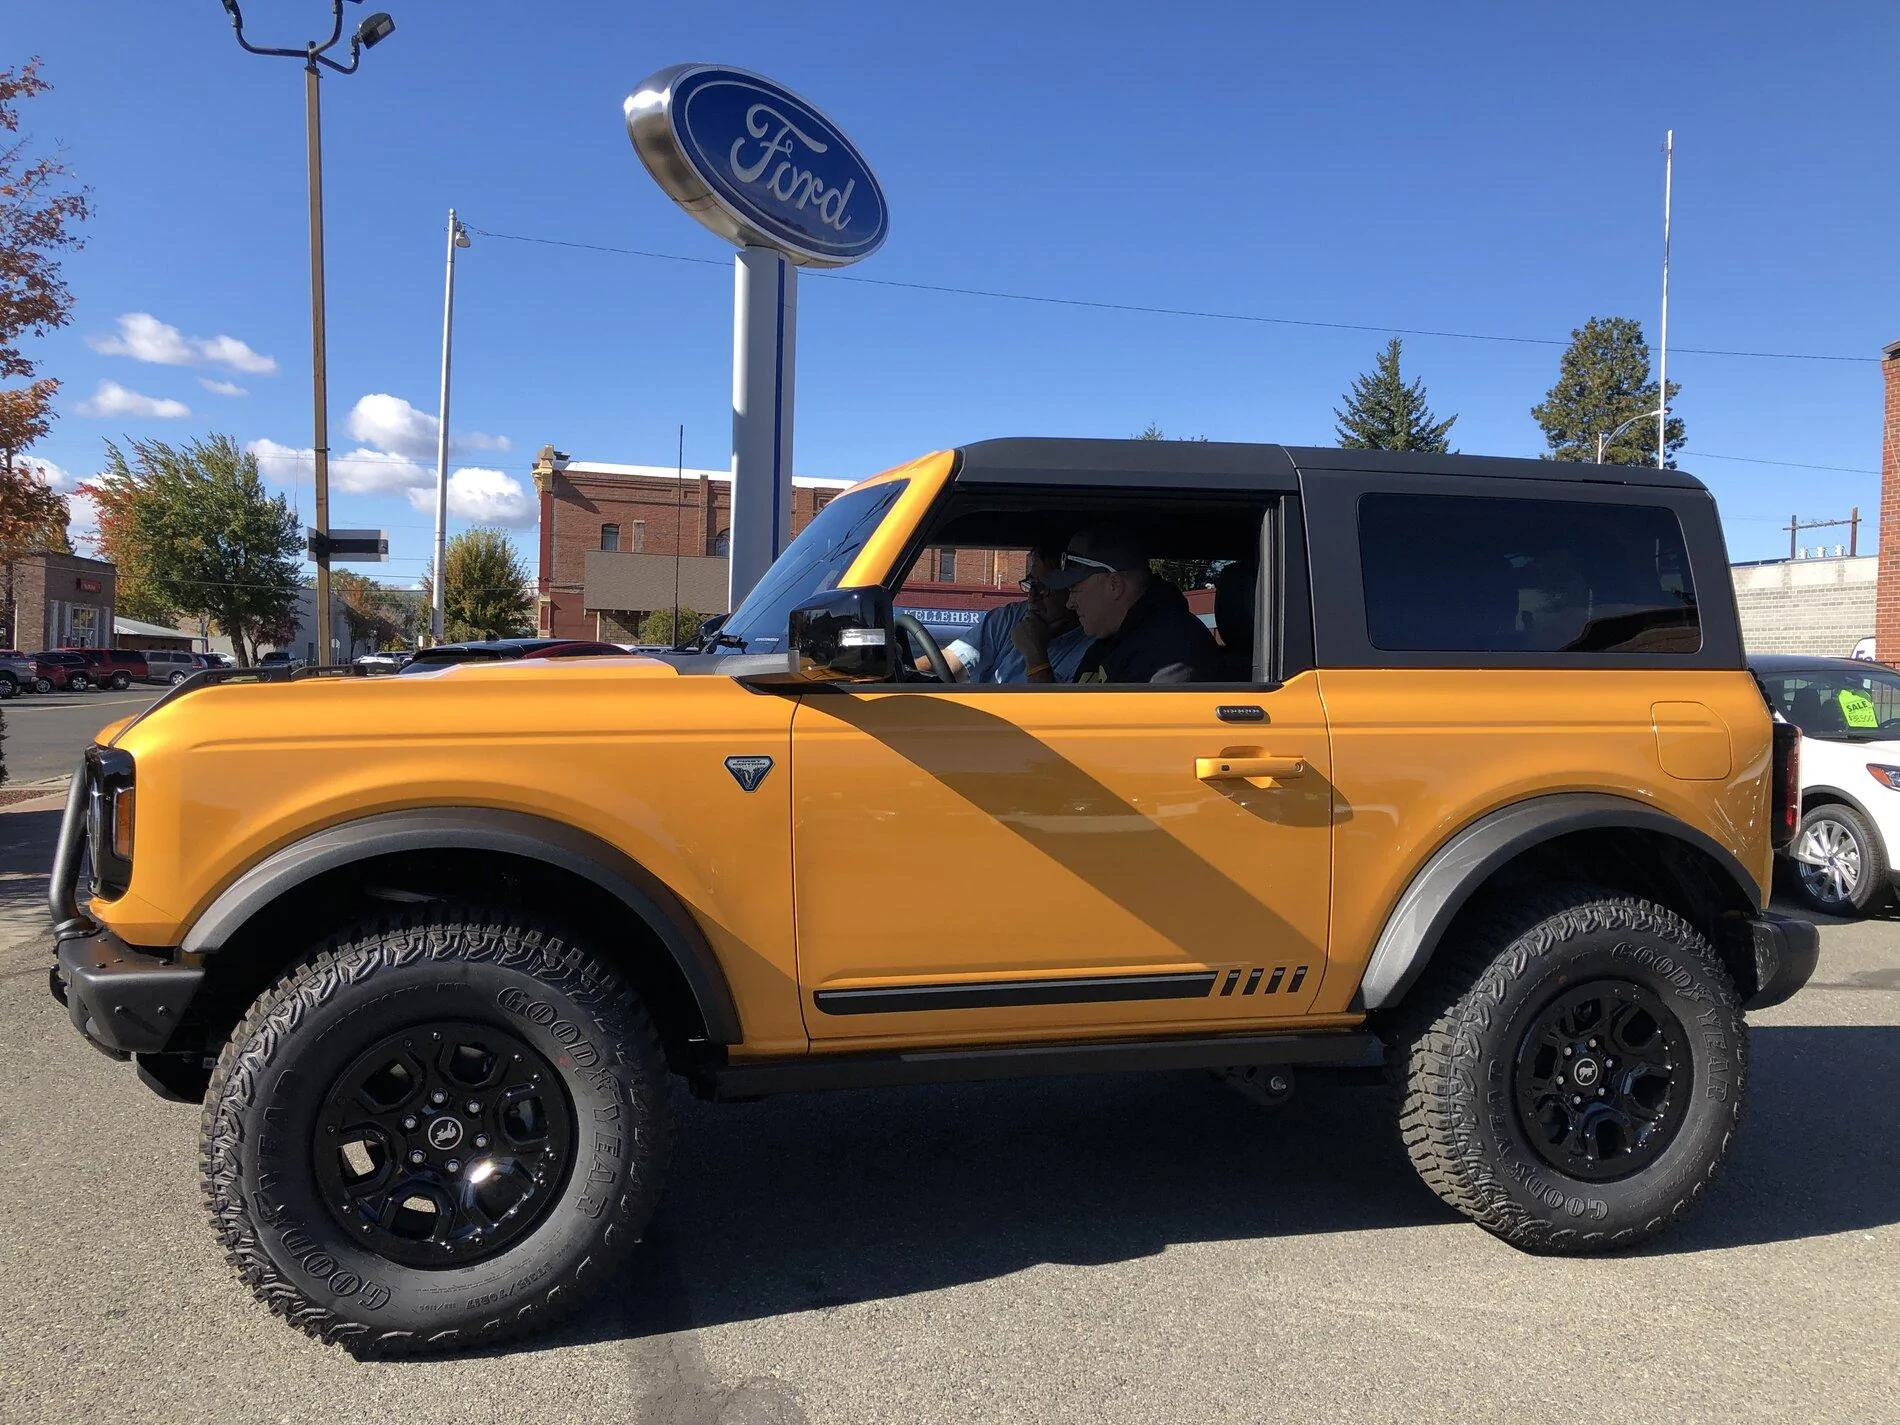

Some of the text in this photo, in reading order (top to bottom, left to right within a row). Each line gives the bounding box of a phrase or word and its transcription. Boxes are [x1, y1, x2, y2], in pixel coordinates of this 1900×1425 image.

[730, 103, 857, 230] Ford
[1846, 700, 1868, 712] SALE
[1611, 941, 1729, 1101] GOODYEAR
[497, 986, 621, 1219] GOODYEAR
